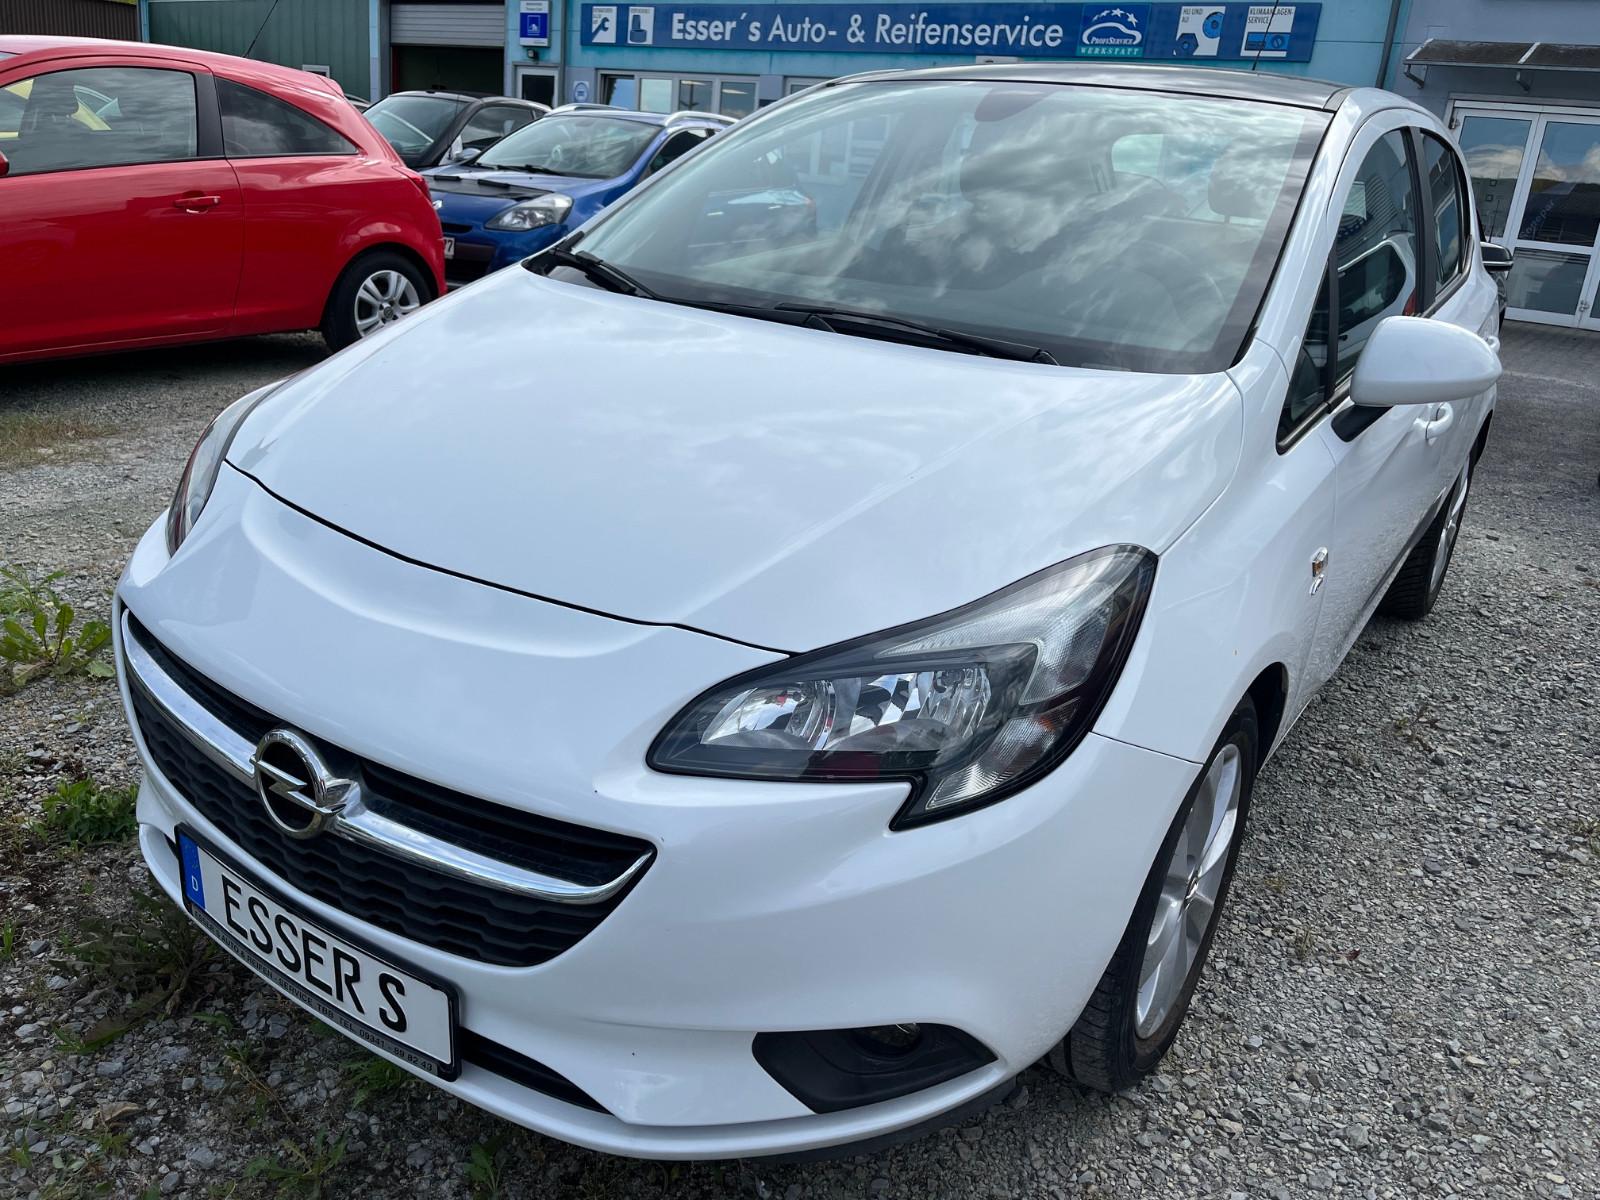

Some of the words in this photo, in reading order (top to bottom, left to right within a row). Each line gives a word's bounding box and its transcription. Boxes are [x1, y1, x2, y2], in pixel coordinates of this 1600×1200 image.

[768, 13, 837, 43] Auto-
[846, 14, 865, 44] &
[875, 12, 1063, 47] Reifenservice
[1081, 47, 1139, 55] WERKSTATT
[191, 875, 199, 892] D
[221, 934, 239, 953] AUTO
[222, 873, 365, 1014] ESSER
[378, 972, 407, 1033] S
